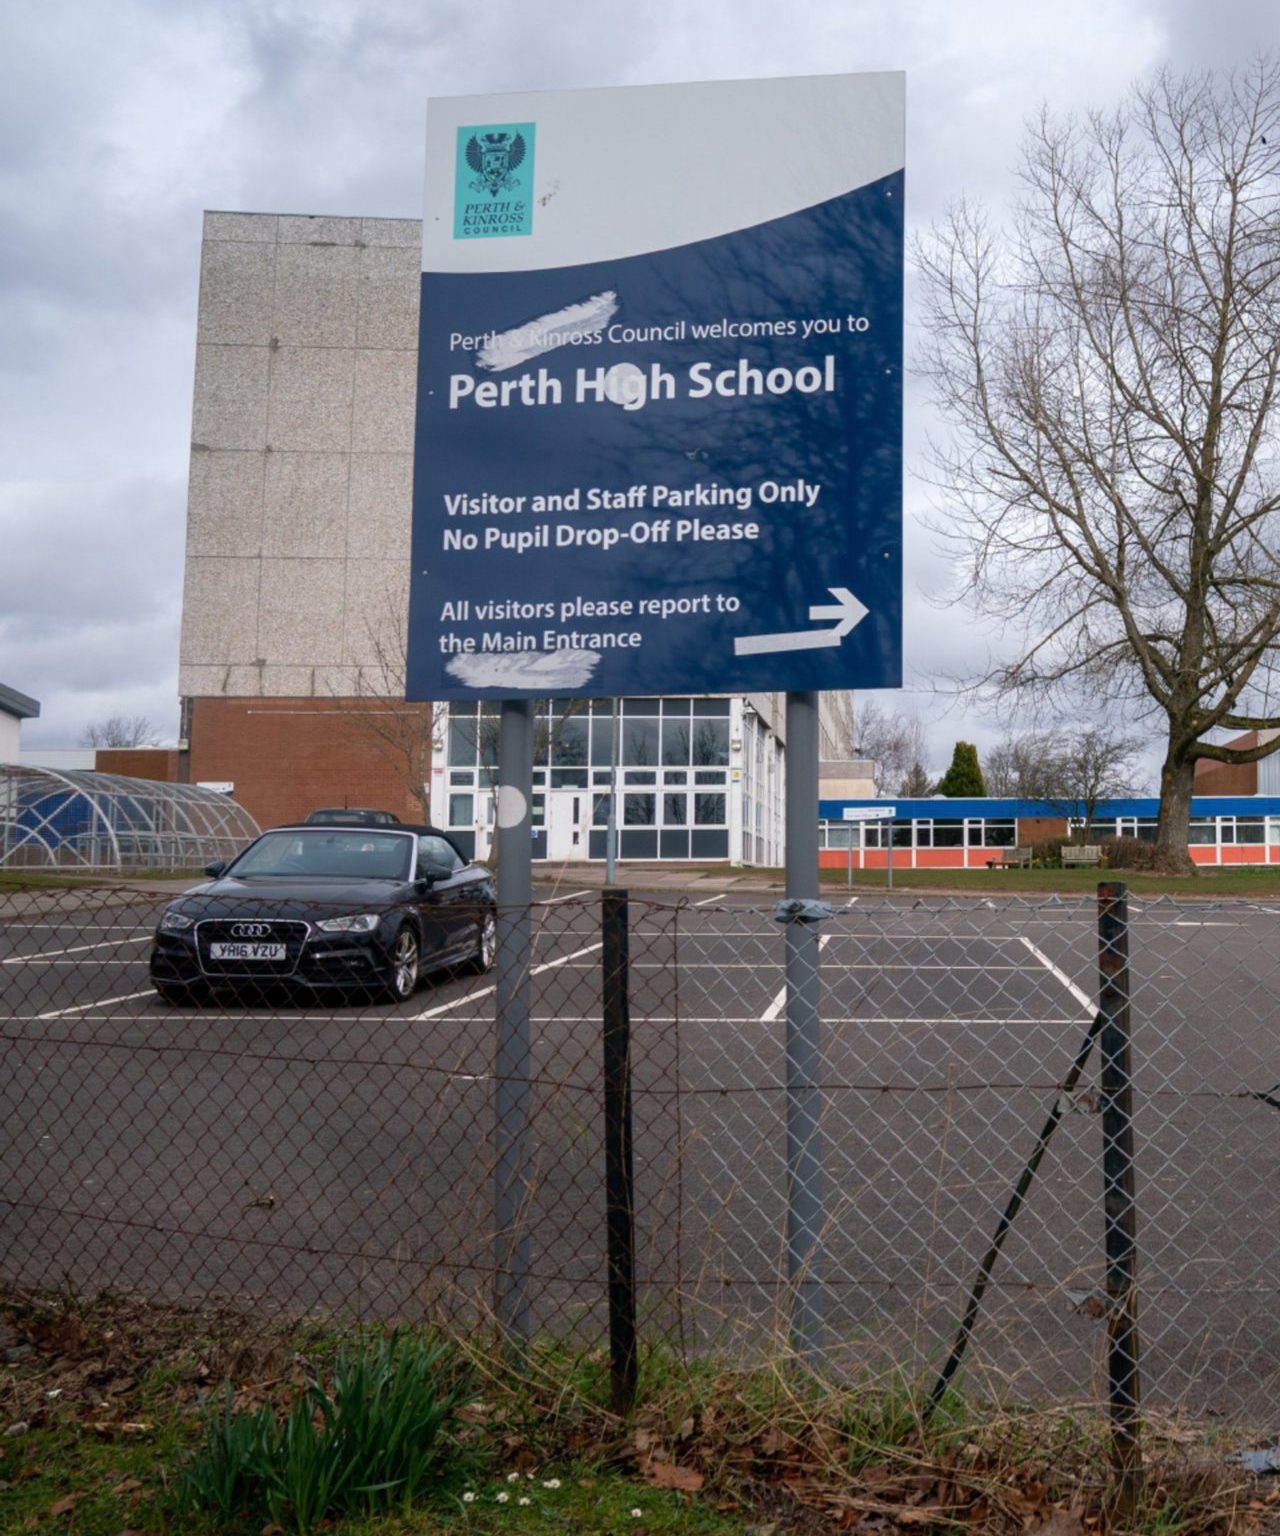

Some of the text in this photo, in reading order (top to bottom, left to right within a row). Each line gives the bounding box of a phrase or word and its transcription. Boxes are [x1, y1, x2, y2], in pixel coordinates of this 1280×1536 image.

[463, 212, 525, 226] KINROSS
[465, 201, 525, 214] PERTH &
[464, 225, 522, 235] COUNCIL
[450, 330, 500, 351] Perth
[530, 329, 602, 347] Kinross
[608, 321, 685, 343] Council
[691, 318, 797, 339] welcomes
[802, 318, 841, 339] you
[847, 314, 870, 332] to
[449, 355, 835, 411] Perth High School
[443, 479, 821, 516] Visitor and Staff Parking Only
[443, 518, 760, 554] No Pupil Drop-Off Please
[440, 593, 740, 623] All visitors please report to
[439, 630, 642, 653] the Main Entrance
[252, 944, 278, 957] VZU
